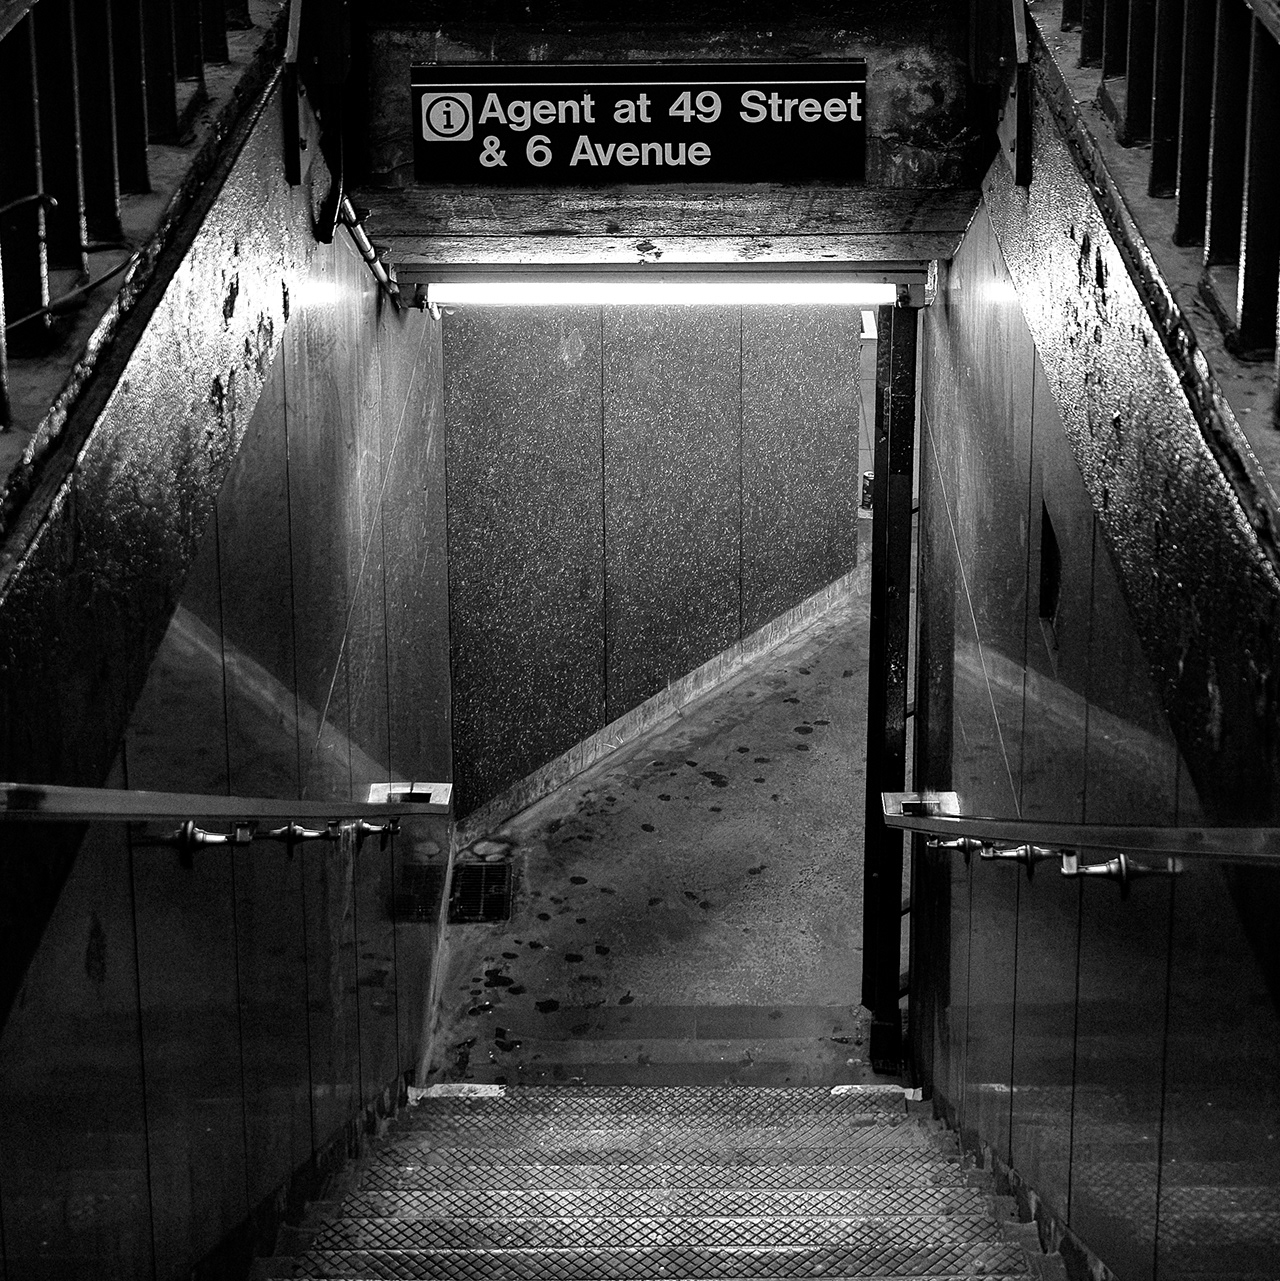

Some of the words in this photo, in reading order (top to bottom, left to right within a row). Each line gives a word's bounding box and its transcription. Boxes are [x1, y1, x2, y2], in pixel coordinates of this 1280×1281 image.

[478, 92, 596, 132] Agent
[613, 93, 652, 124] at
[668, 90, 722, 124] 49
[739, 89, 862, 123] Street
[478, 135, 508, 168] &
[525, 134, 553, 168] 6
[569, 134, 712, 167] Avenue
